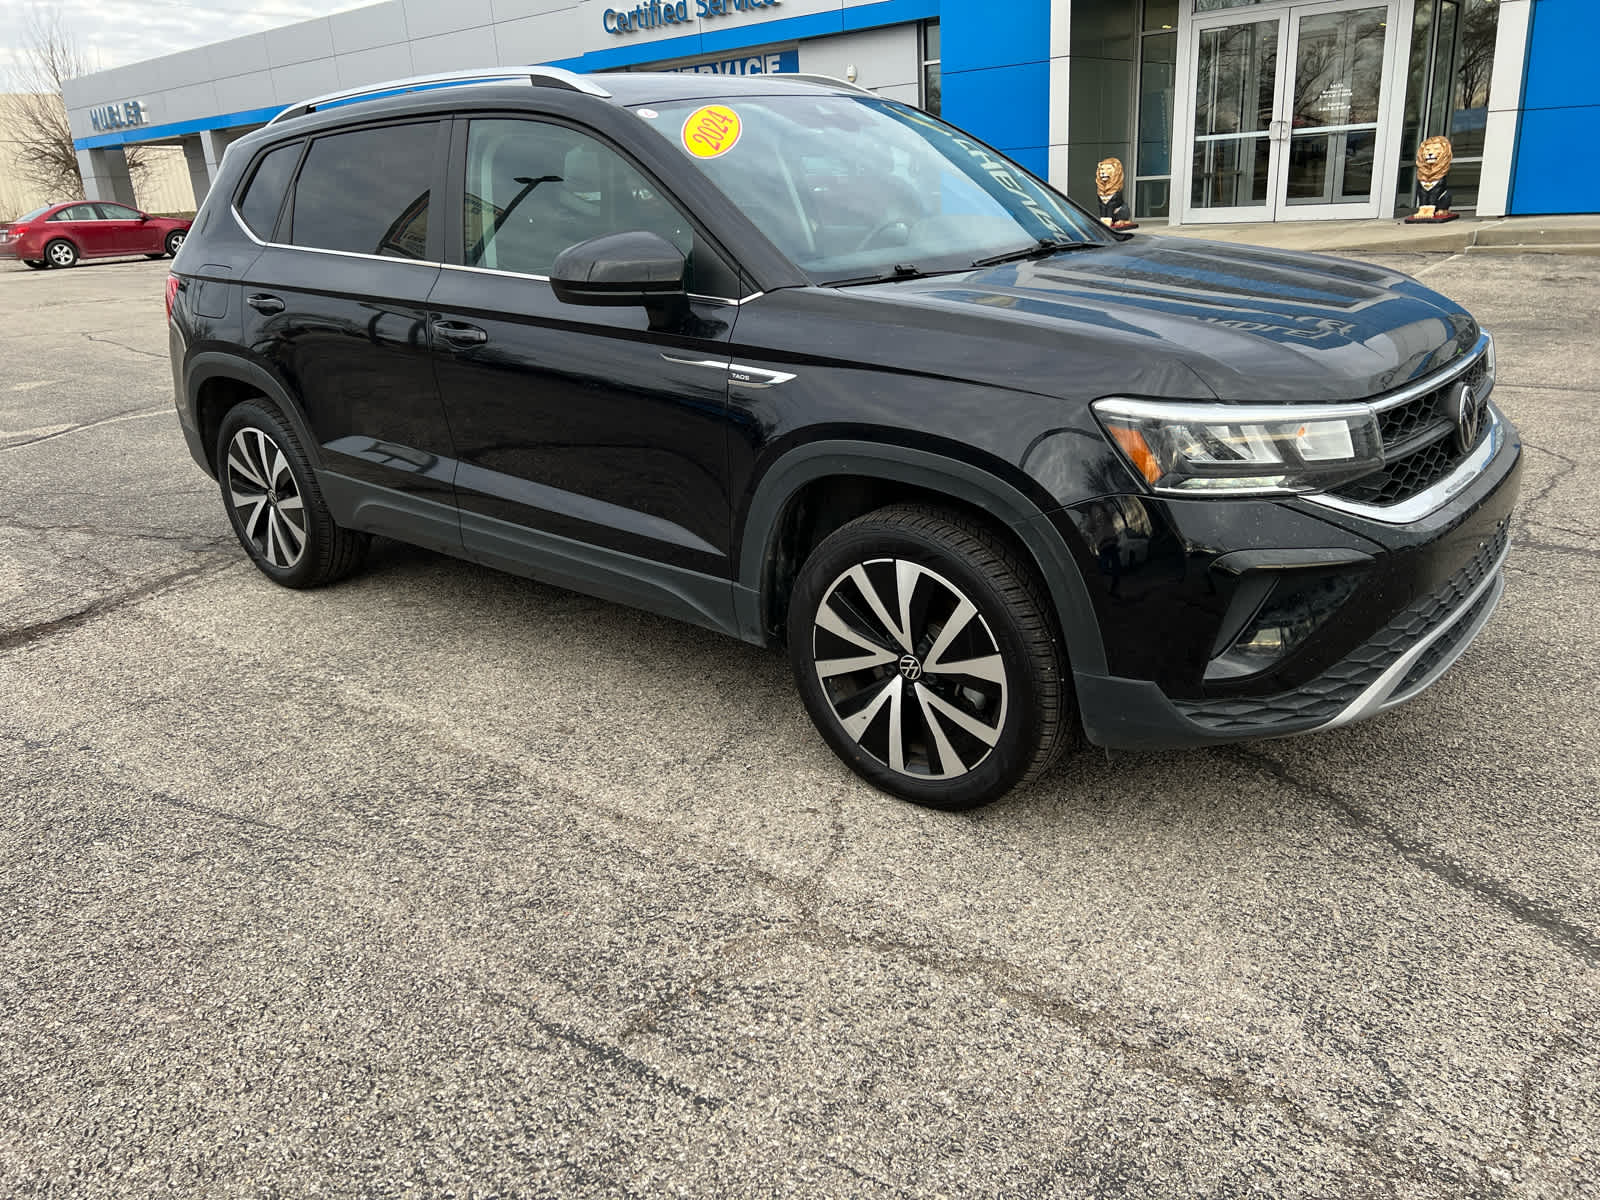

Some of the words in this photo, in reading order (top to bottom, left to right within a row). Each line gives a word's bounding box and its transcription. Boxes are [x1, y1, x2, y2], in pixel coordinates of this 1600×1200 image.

[603, 0, 689, 34] Certified
[696, 0, 775, 17] Serv
[692, 109, 733, 151] 2024
[732, 373, 750, 381] TAOS
